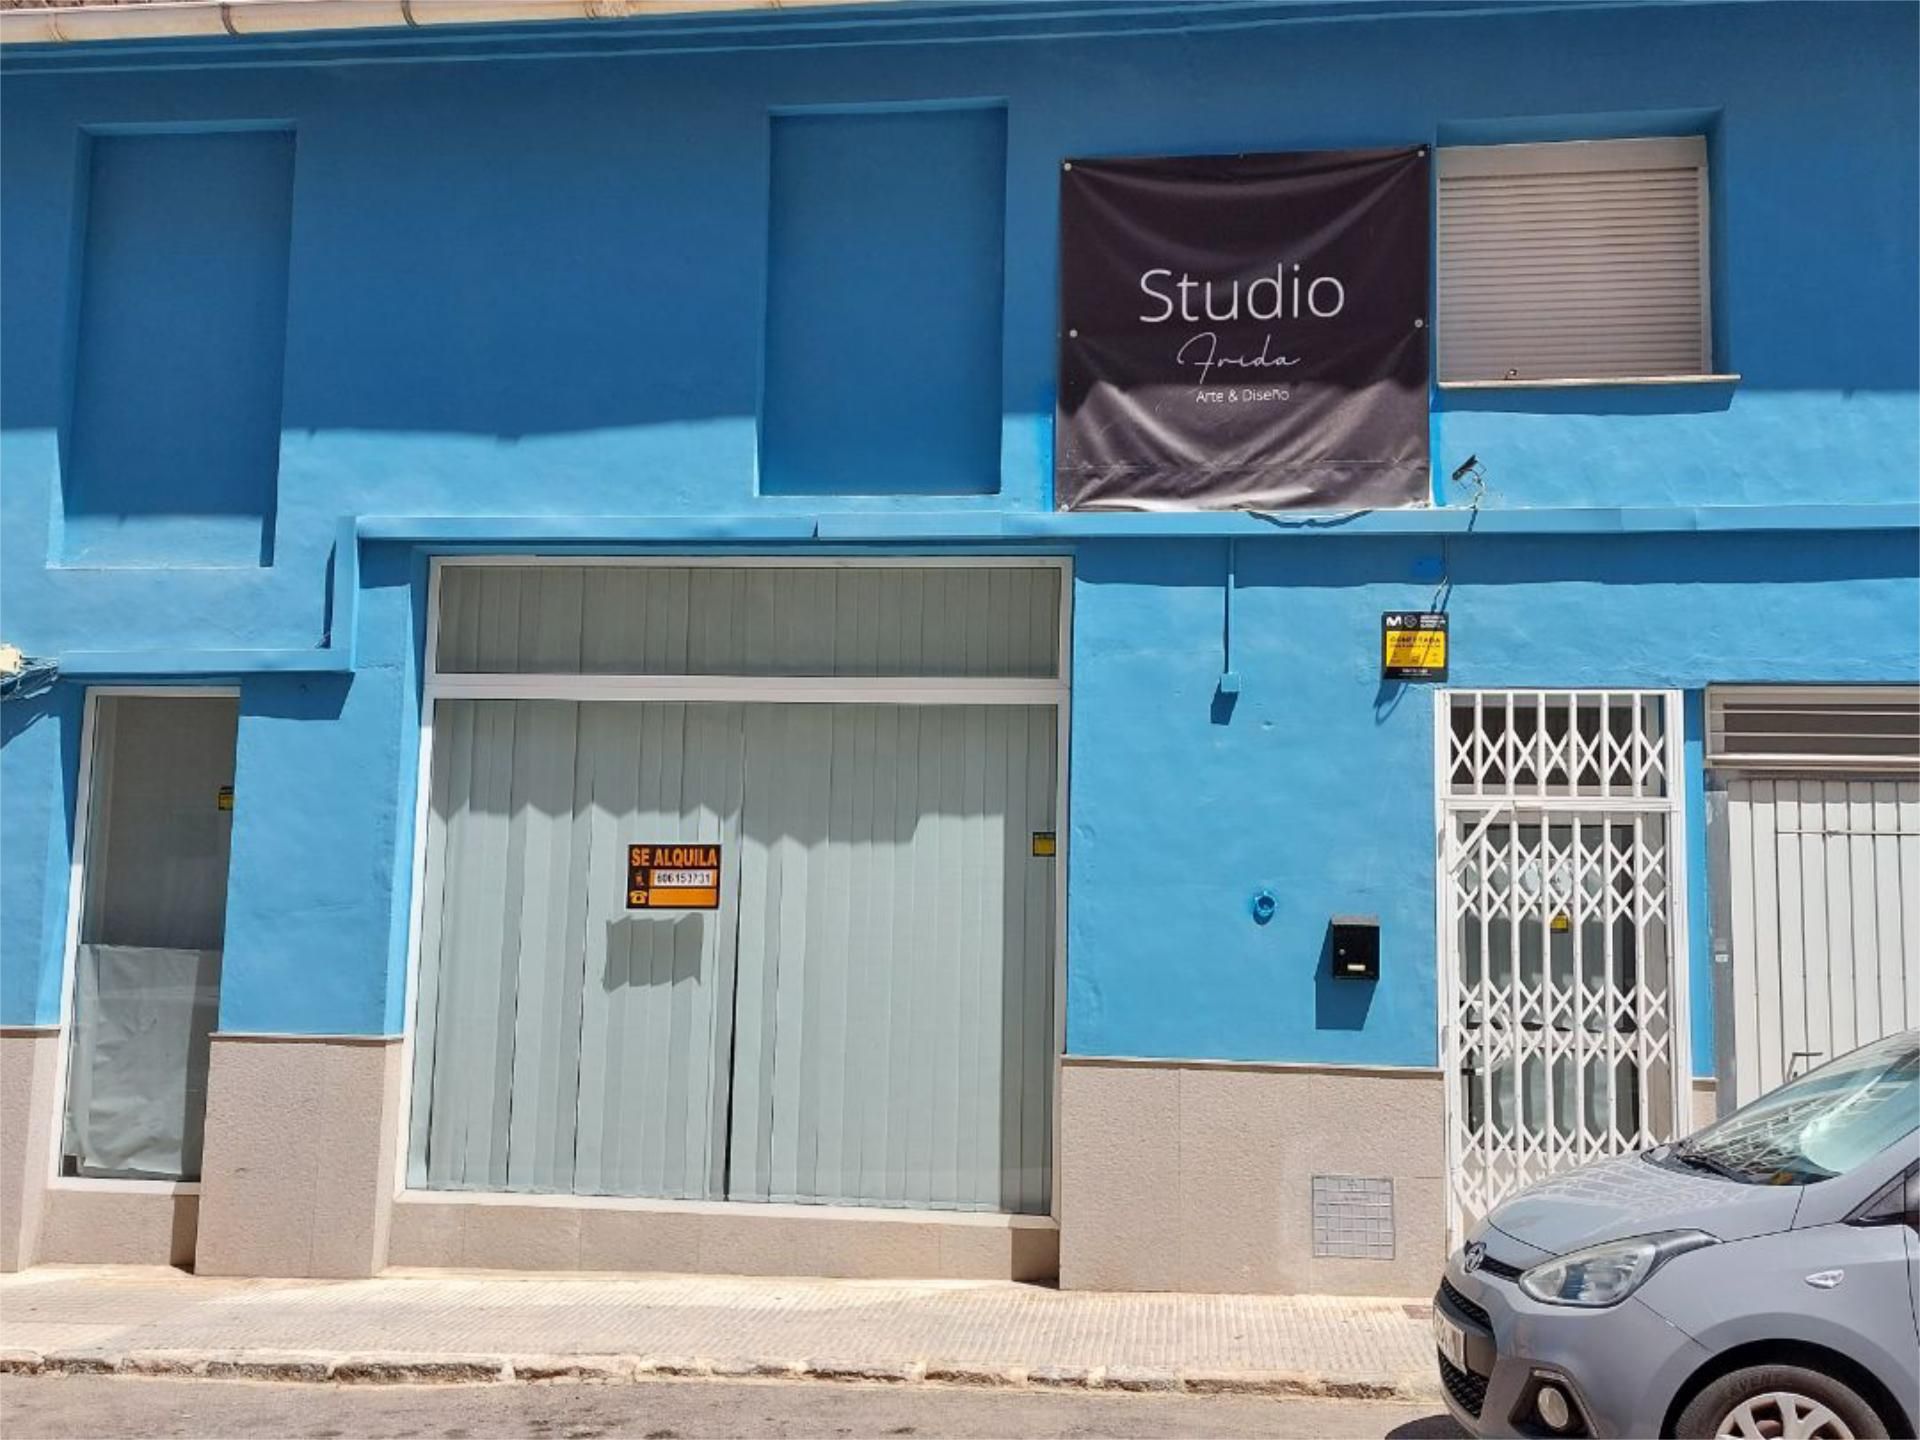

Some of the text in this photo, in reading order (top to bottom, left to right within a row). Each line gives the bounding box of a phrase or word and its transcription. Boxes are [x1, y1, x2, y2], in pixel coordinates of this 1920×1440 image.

[1139, 262, 1345, 323] Studio
[1176, 331, 1301, 384] Frida
[1196, 388, 1290, 403] Arte & Diseño
[632, 847, 717, 867] SE ALQUILA
